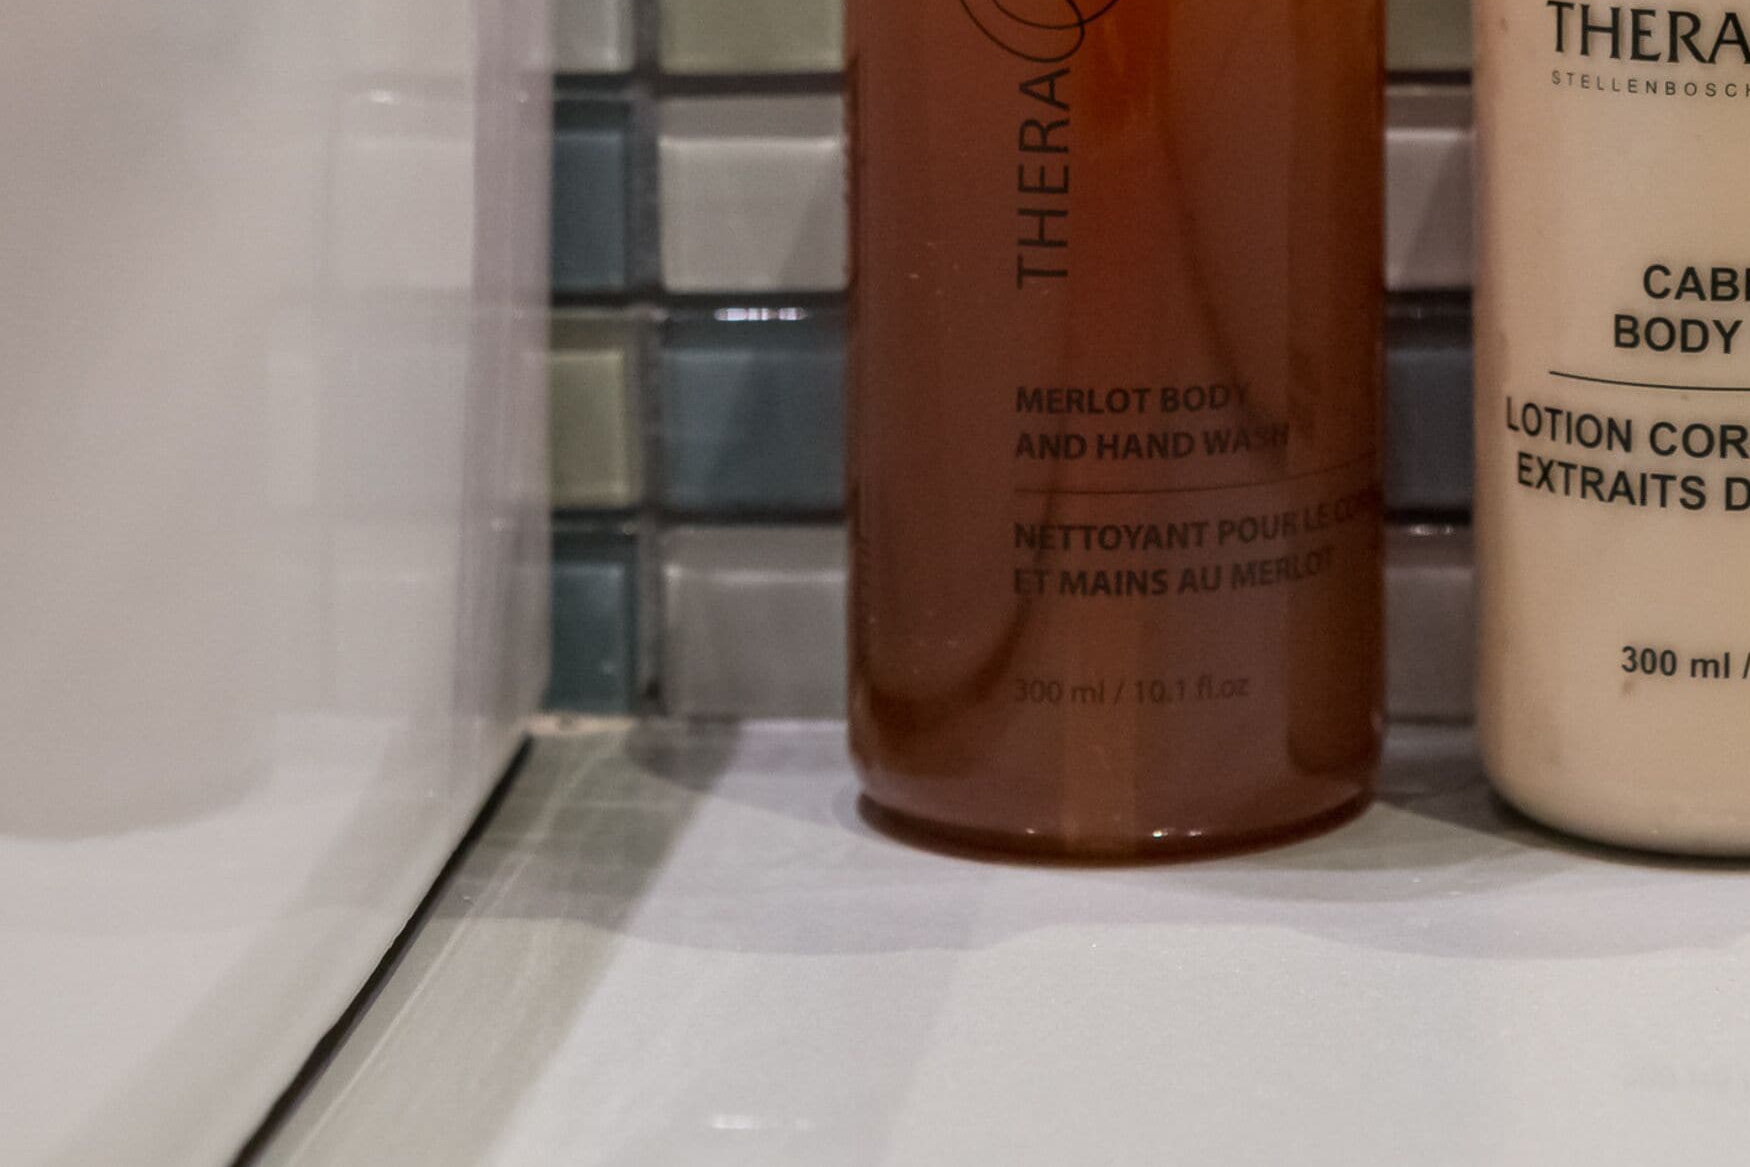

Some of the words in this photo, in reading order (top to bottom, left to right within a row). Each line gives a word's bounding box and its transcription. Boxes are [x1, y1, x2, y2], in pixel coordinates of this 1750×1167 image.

[1613, 313, 1743, 354] BODY
[1015, 386, 1151, 415] MERLOT
[1160, 383, 1250, 413] BODY
[1014, 432, 1088, 460] AND
[1097, 431, 1196, 461] HAND
[1203, 422, 1291, 456] WASH
[1506, 395, 1633, 454] LOTION
[1517, 451, 1707, 511] EXTRAITS
[1013, 521, 1210, 552] NETTOYANT
[1218, 510, 1299, 546] POUR
[1013, 568, 1050, 597] ET
[1058, 568, 1169, 597] MAINS
[1177, 564, 1223, 595] AU
[1231, 544, 1335, 589] MERLOT
[1620, 645, 1678, 677] 300
[1690, 651, 1731, 679] ml
[1015, 678, 1062, 704] 300
[1071, 677, 1106, 704] ml
[1135, 677, 1185, 705] 10.1
